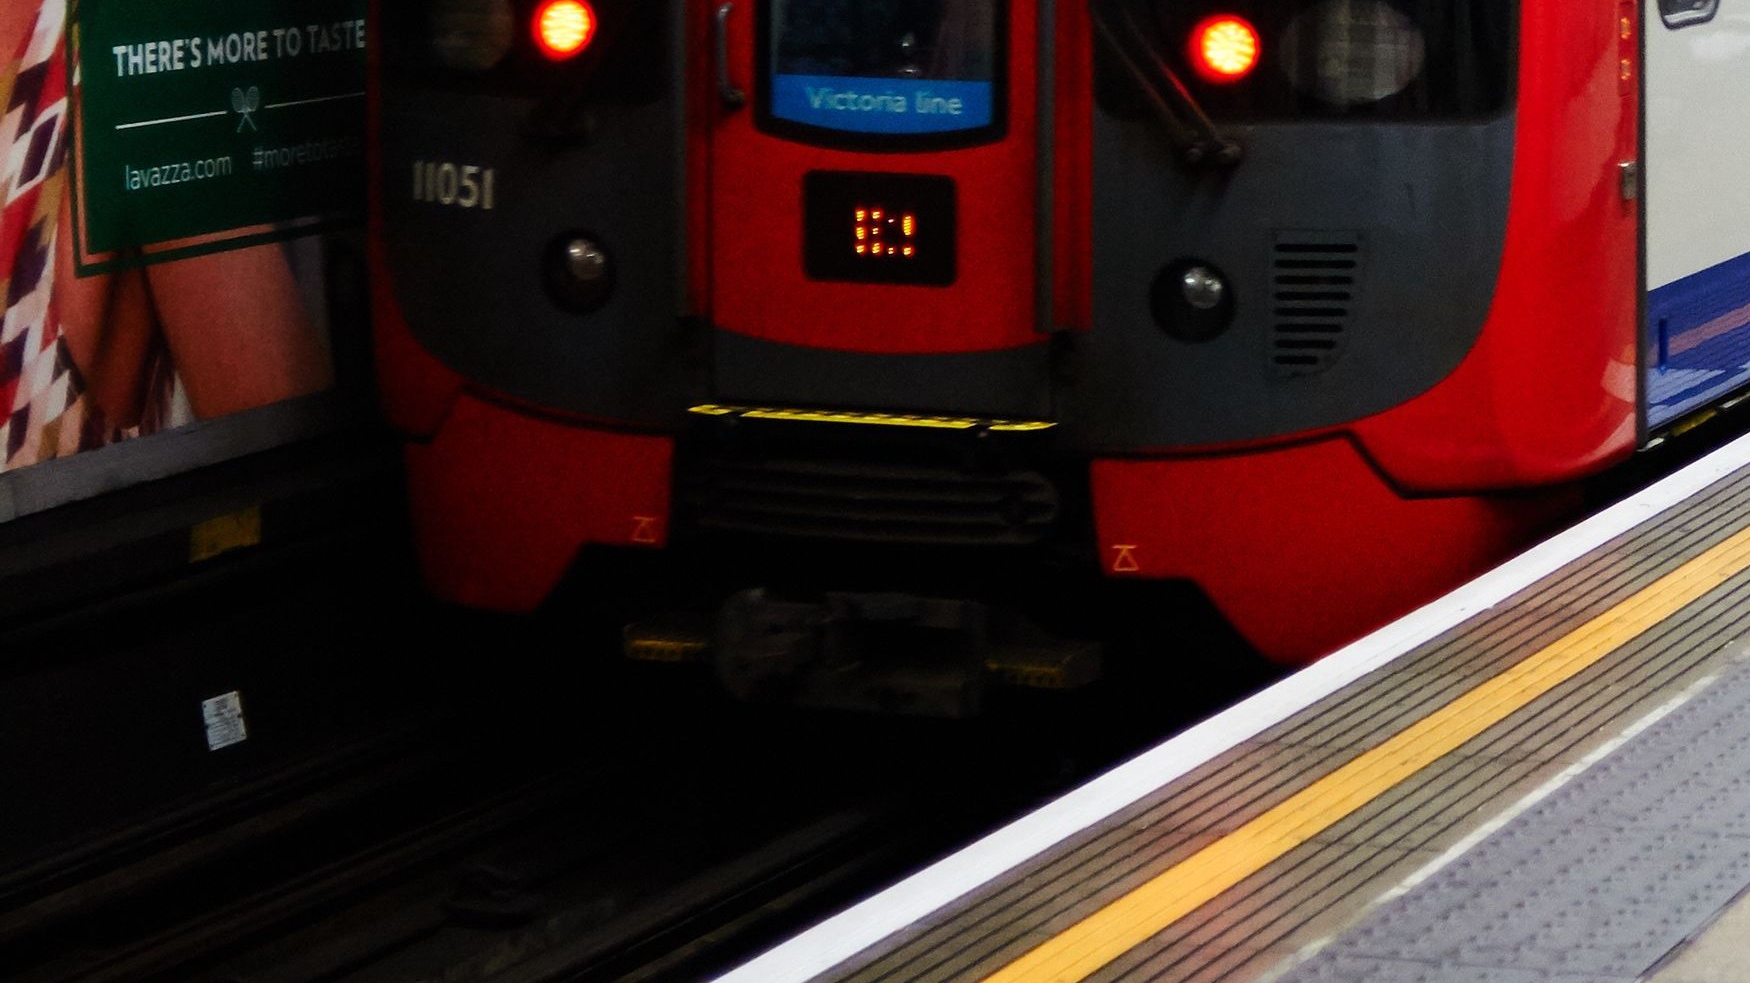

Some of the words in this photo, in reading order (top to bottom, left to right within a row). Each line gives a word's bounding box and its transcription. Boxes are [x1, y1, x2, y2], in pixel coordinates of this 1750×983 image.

[112, 36, 202, 78] THERE'S
[206, 29, 269, 67] MORE
[273, 25, 302, 58] TO
[306, 18, 366, 55] TASTE
[805, 85, 907, 114] Victoria
[914, 89, 963, 116] line
[125, 154, 232, 191] lavazza.com
[411, 158, 497, 210] 11051
